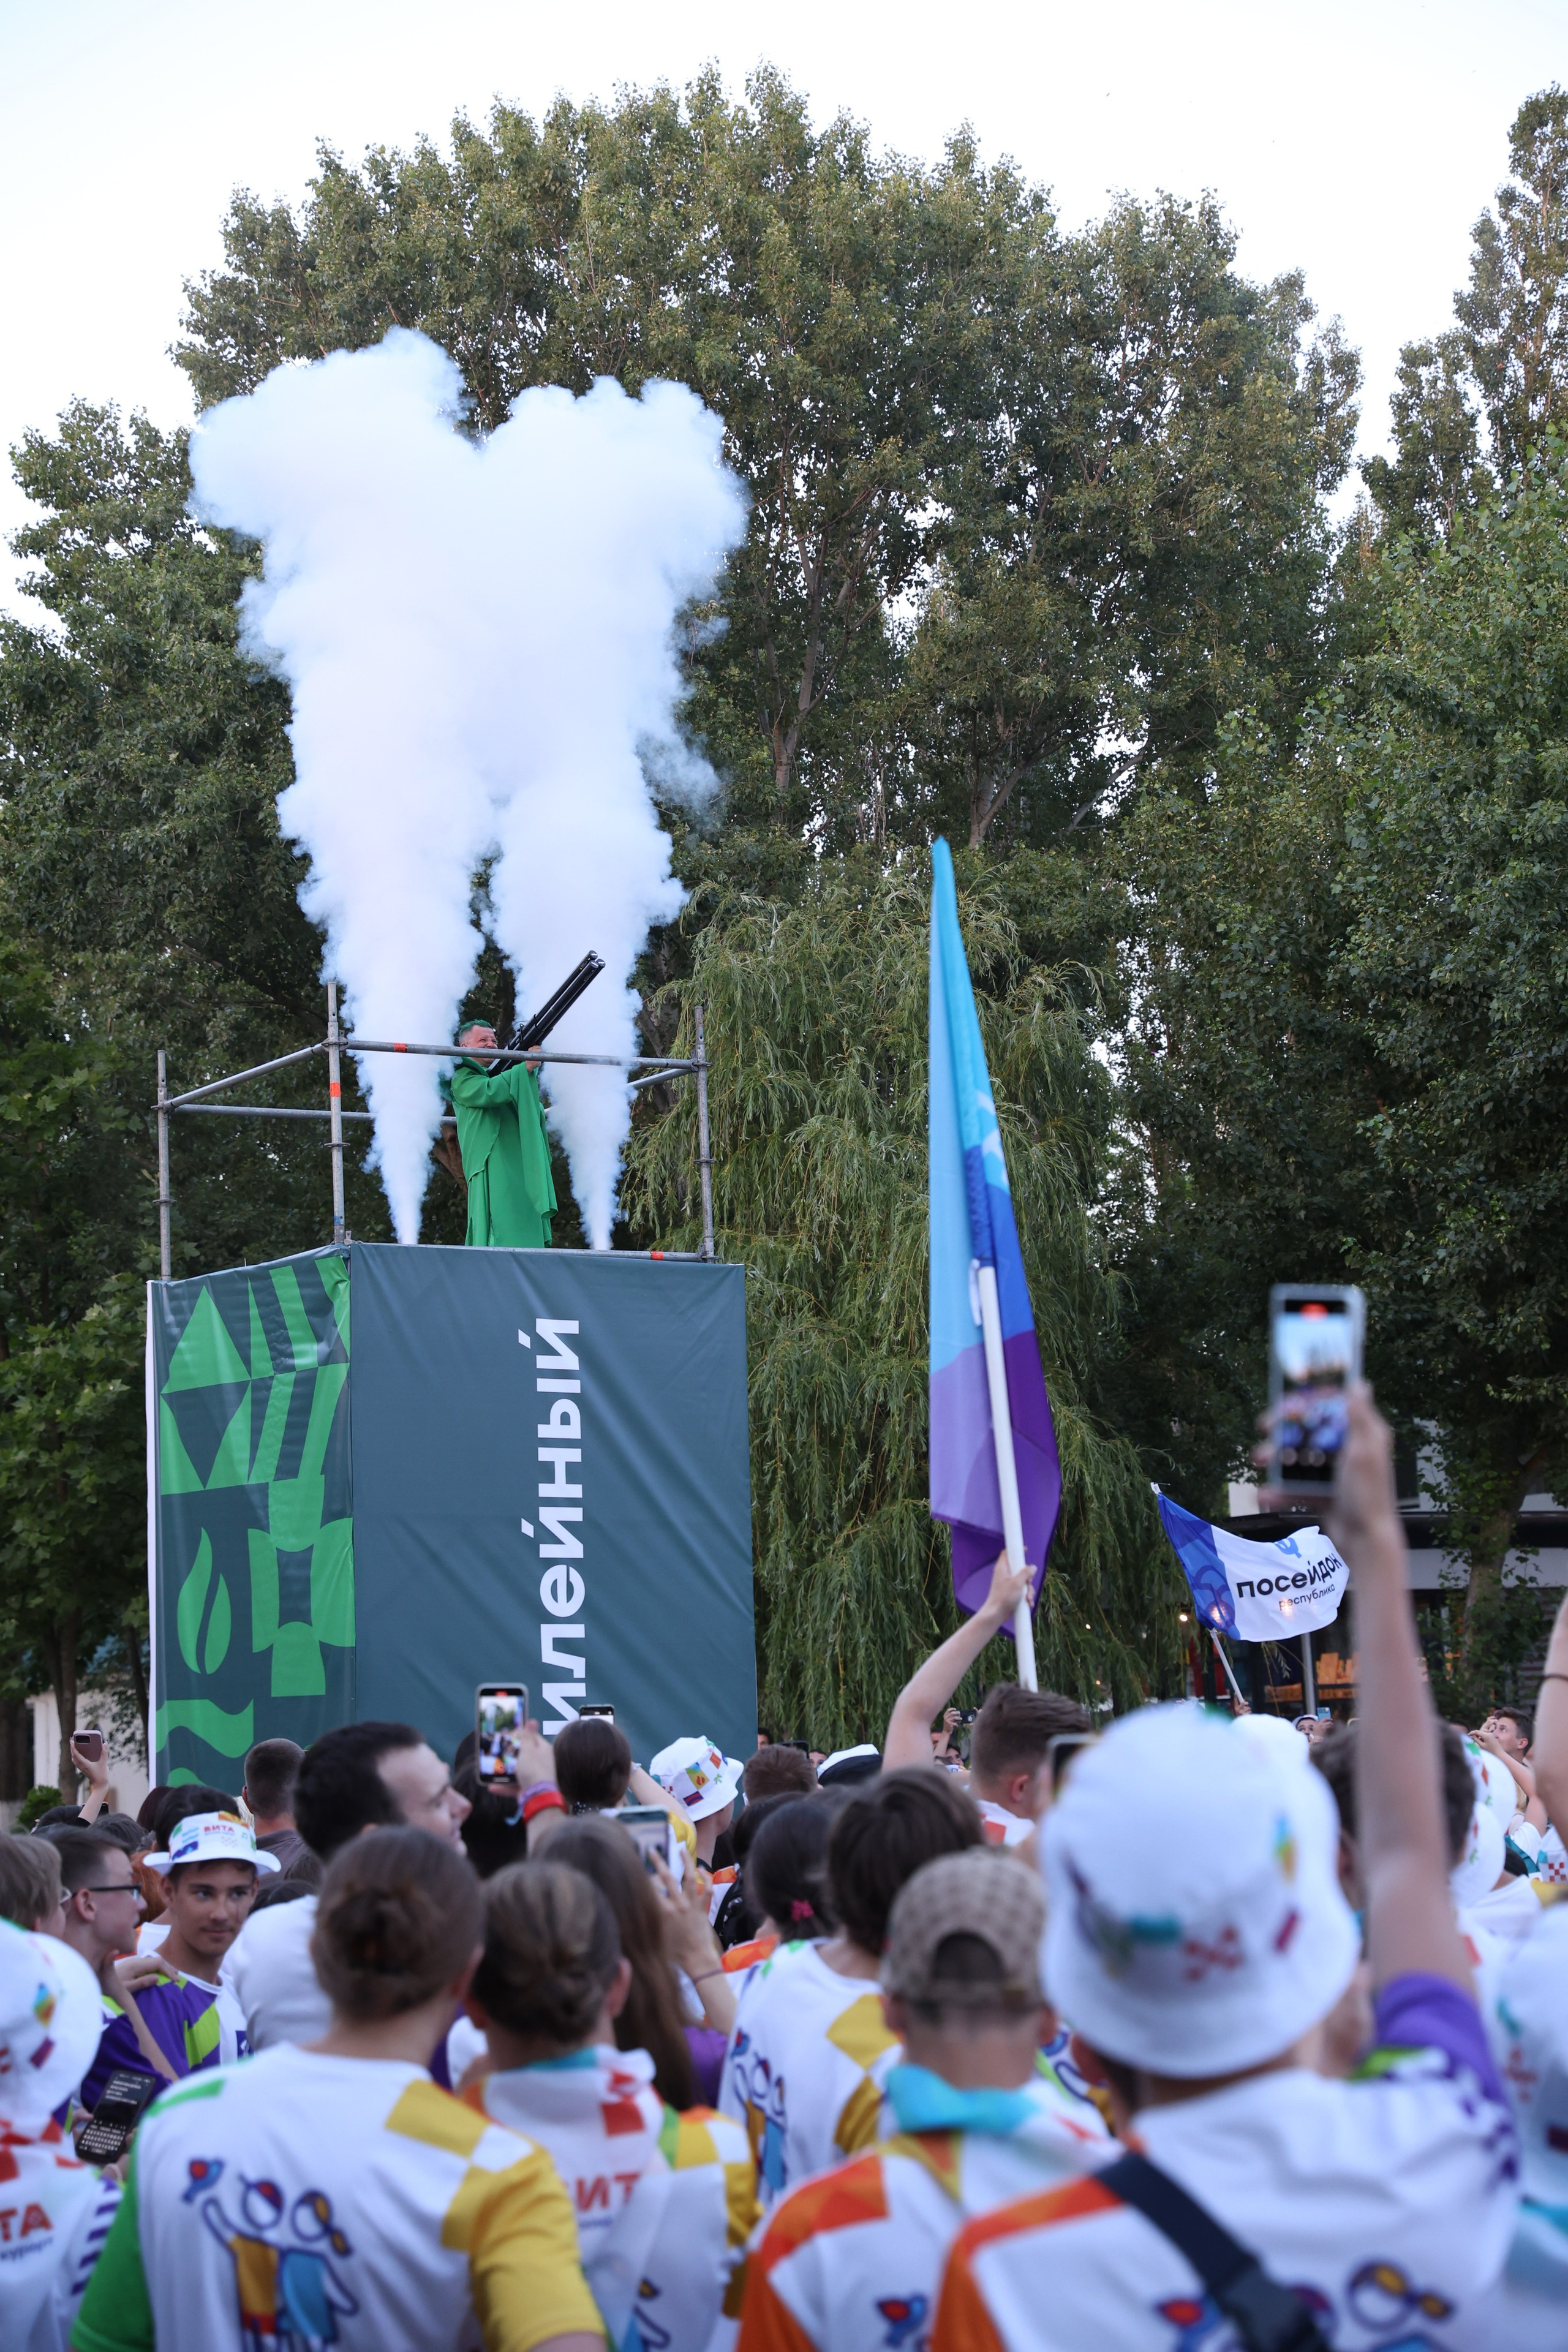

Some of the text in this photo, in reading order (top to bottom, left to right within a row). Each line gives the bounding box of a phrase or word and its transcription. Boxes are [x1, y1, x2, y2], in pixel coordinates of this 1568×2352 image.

[518, 1317, 586, 1735] илейный
[1236, 1553, 1343, 1599] посейдон
[1278, 1584, 1336, 1611] республика
[576, 2173, 641, 2211] ИТ
[0, 2203, 53, 2241] ТА
